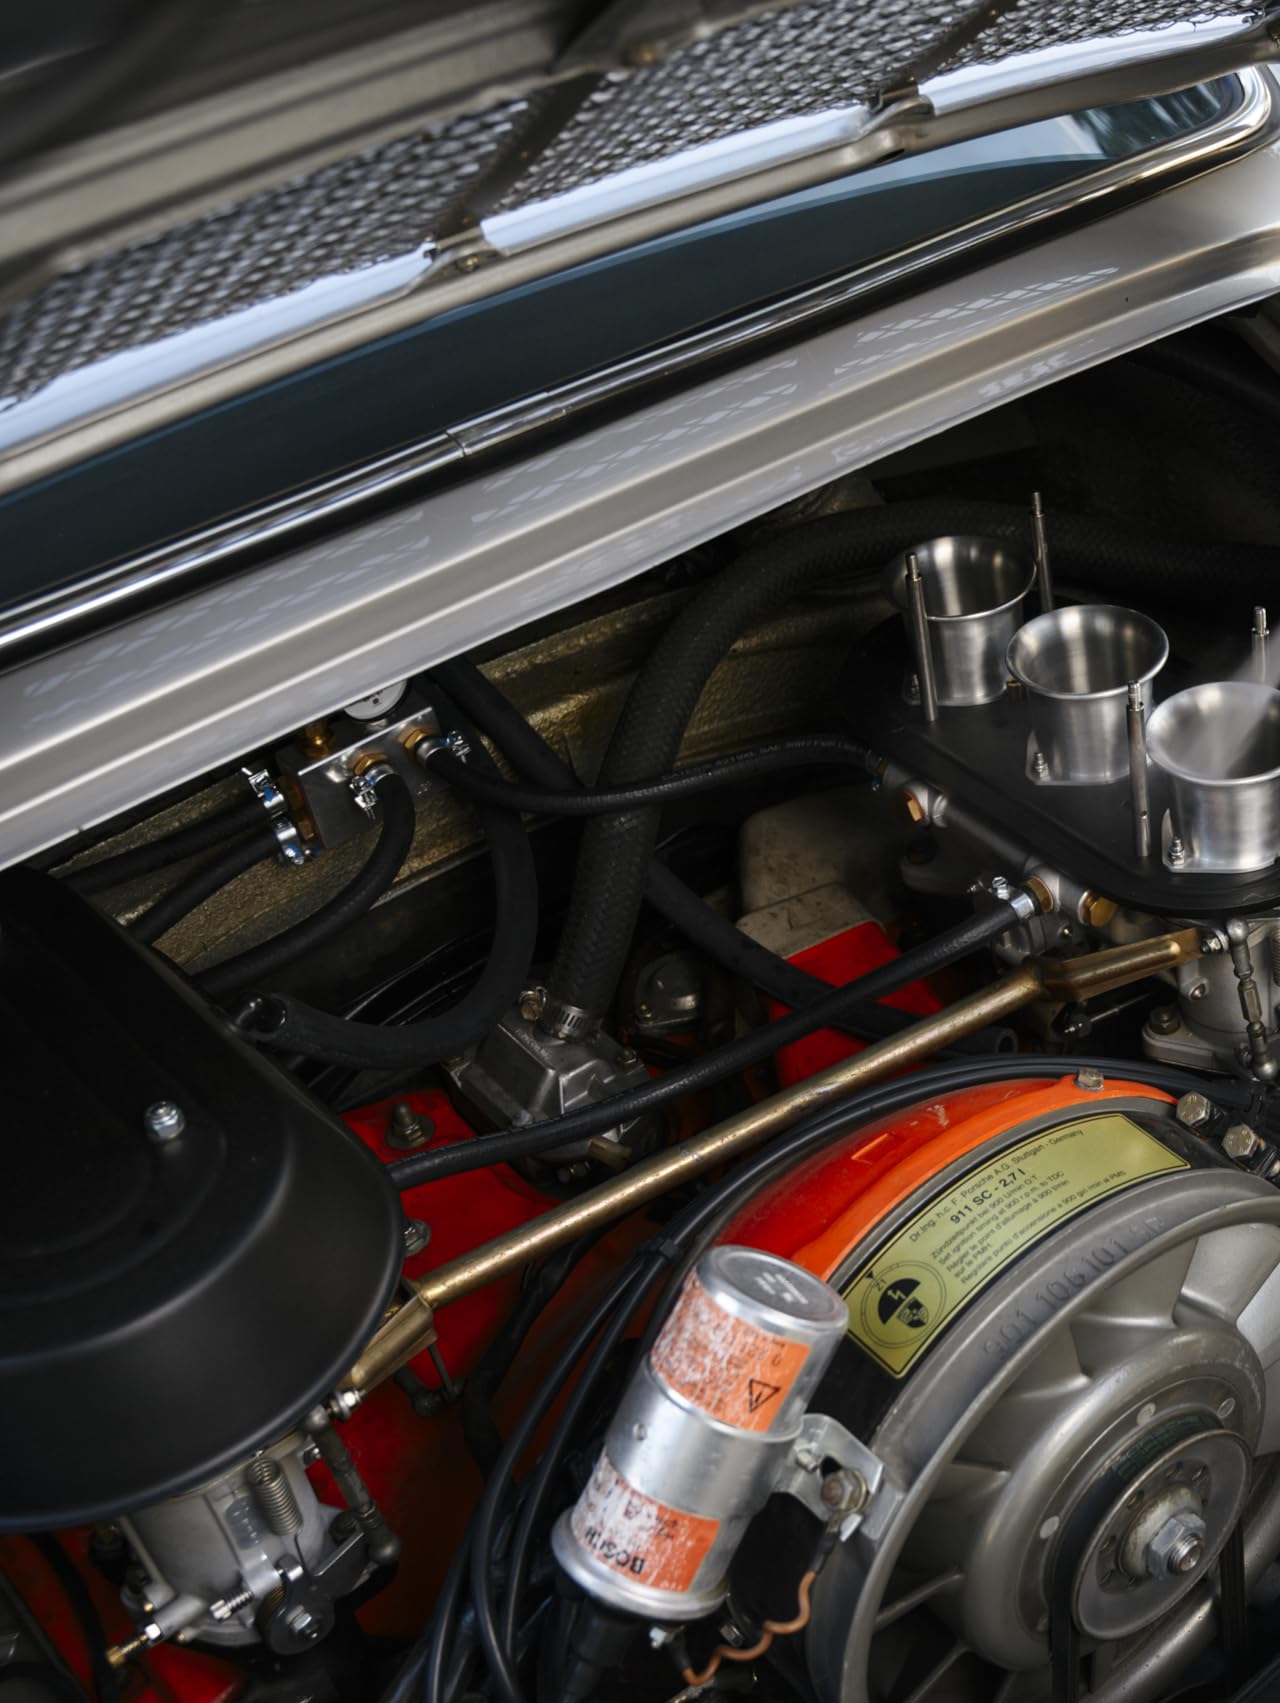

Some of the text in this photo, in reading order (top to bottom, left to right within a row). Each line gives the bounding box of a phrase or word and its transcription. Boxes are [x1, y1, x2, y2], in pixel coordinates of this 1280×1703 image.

[960, 1173, 994, 1198] Porsche
[1012, 1143, 1045, 1165] Stuttgart
[1048, 1129, 1083, 1145] Germany
[1046, 1169, 1065, 1183] TDC
[949, 1203, 973, 1225] 911
[972, 1188, 993, 1207] SC
[998, 1172, 1017, 1188] 2,7
